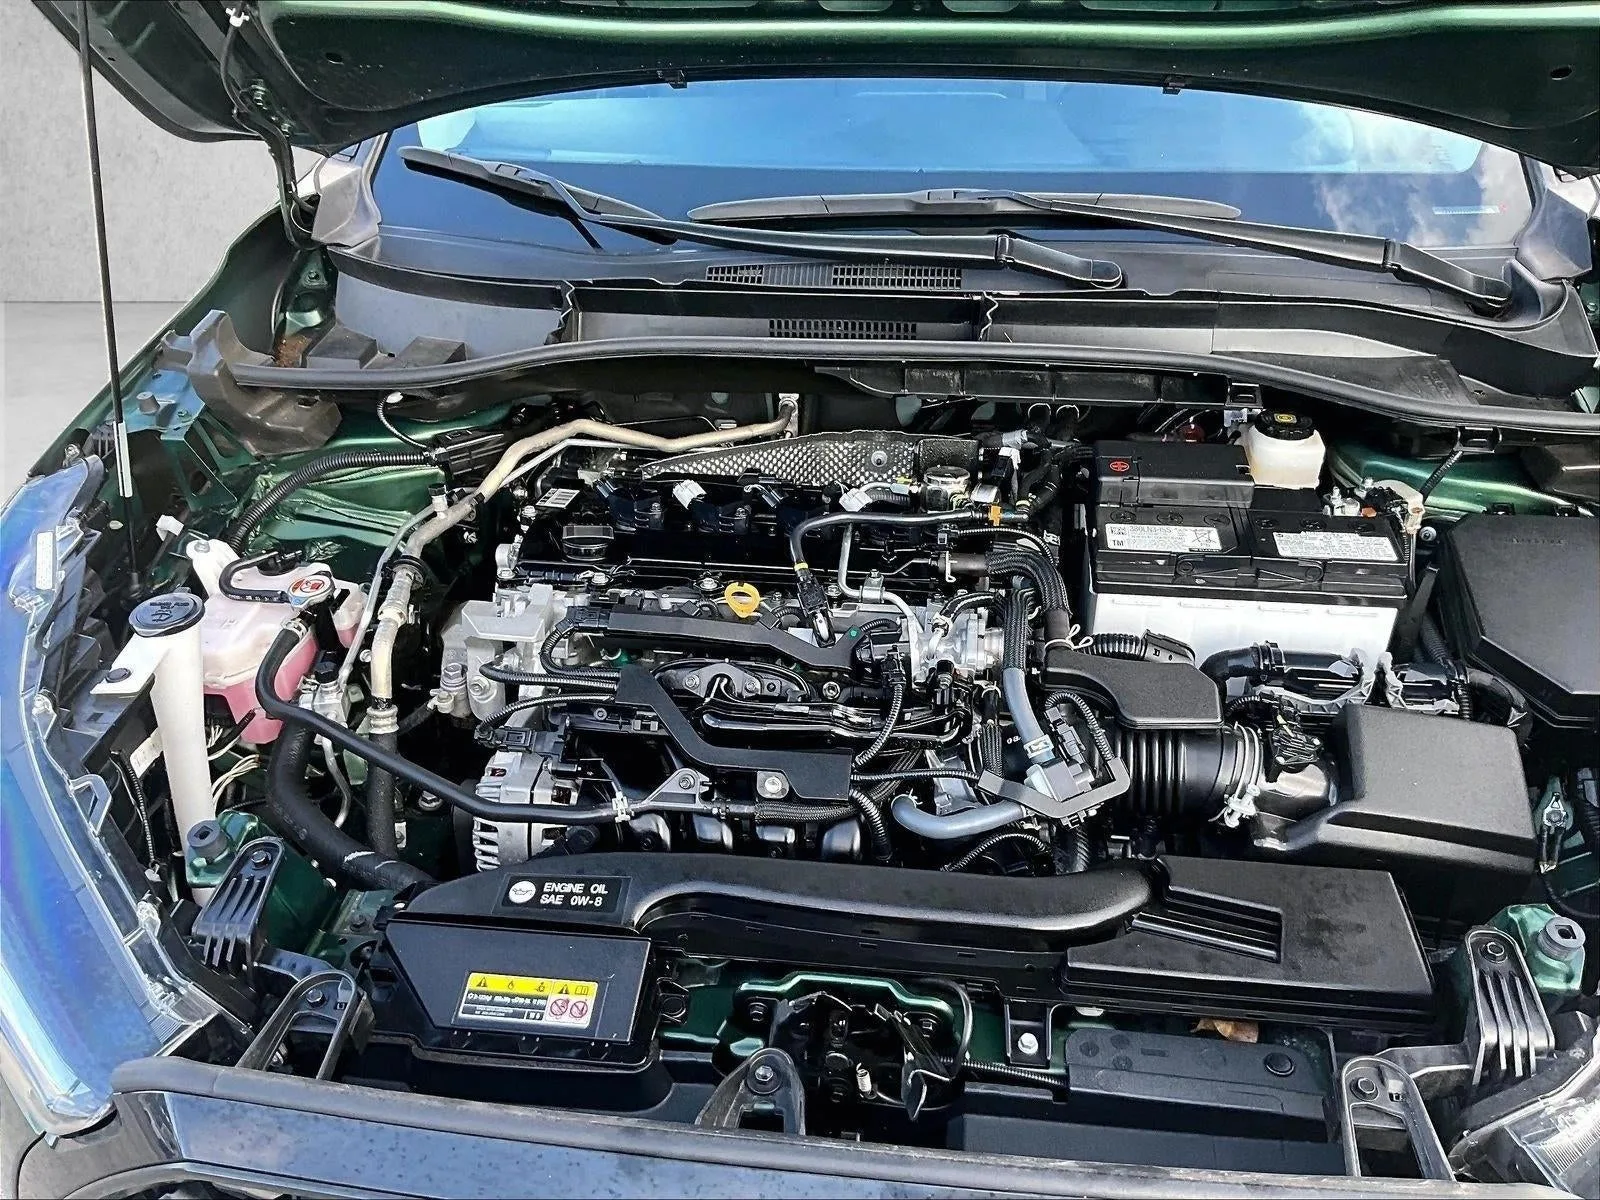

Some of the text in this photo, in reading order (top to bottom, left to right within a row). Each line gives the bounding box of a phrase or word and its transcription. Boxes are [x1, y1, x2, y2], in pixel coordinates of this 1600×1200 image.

[543, 882, 608, 894] ENGINE OIL
[540, 894, 603, 907] SAE 0W-8
